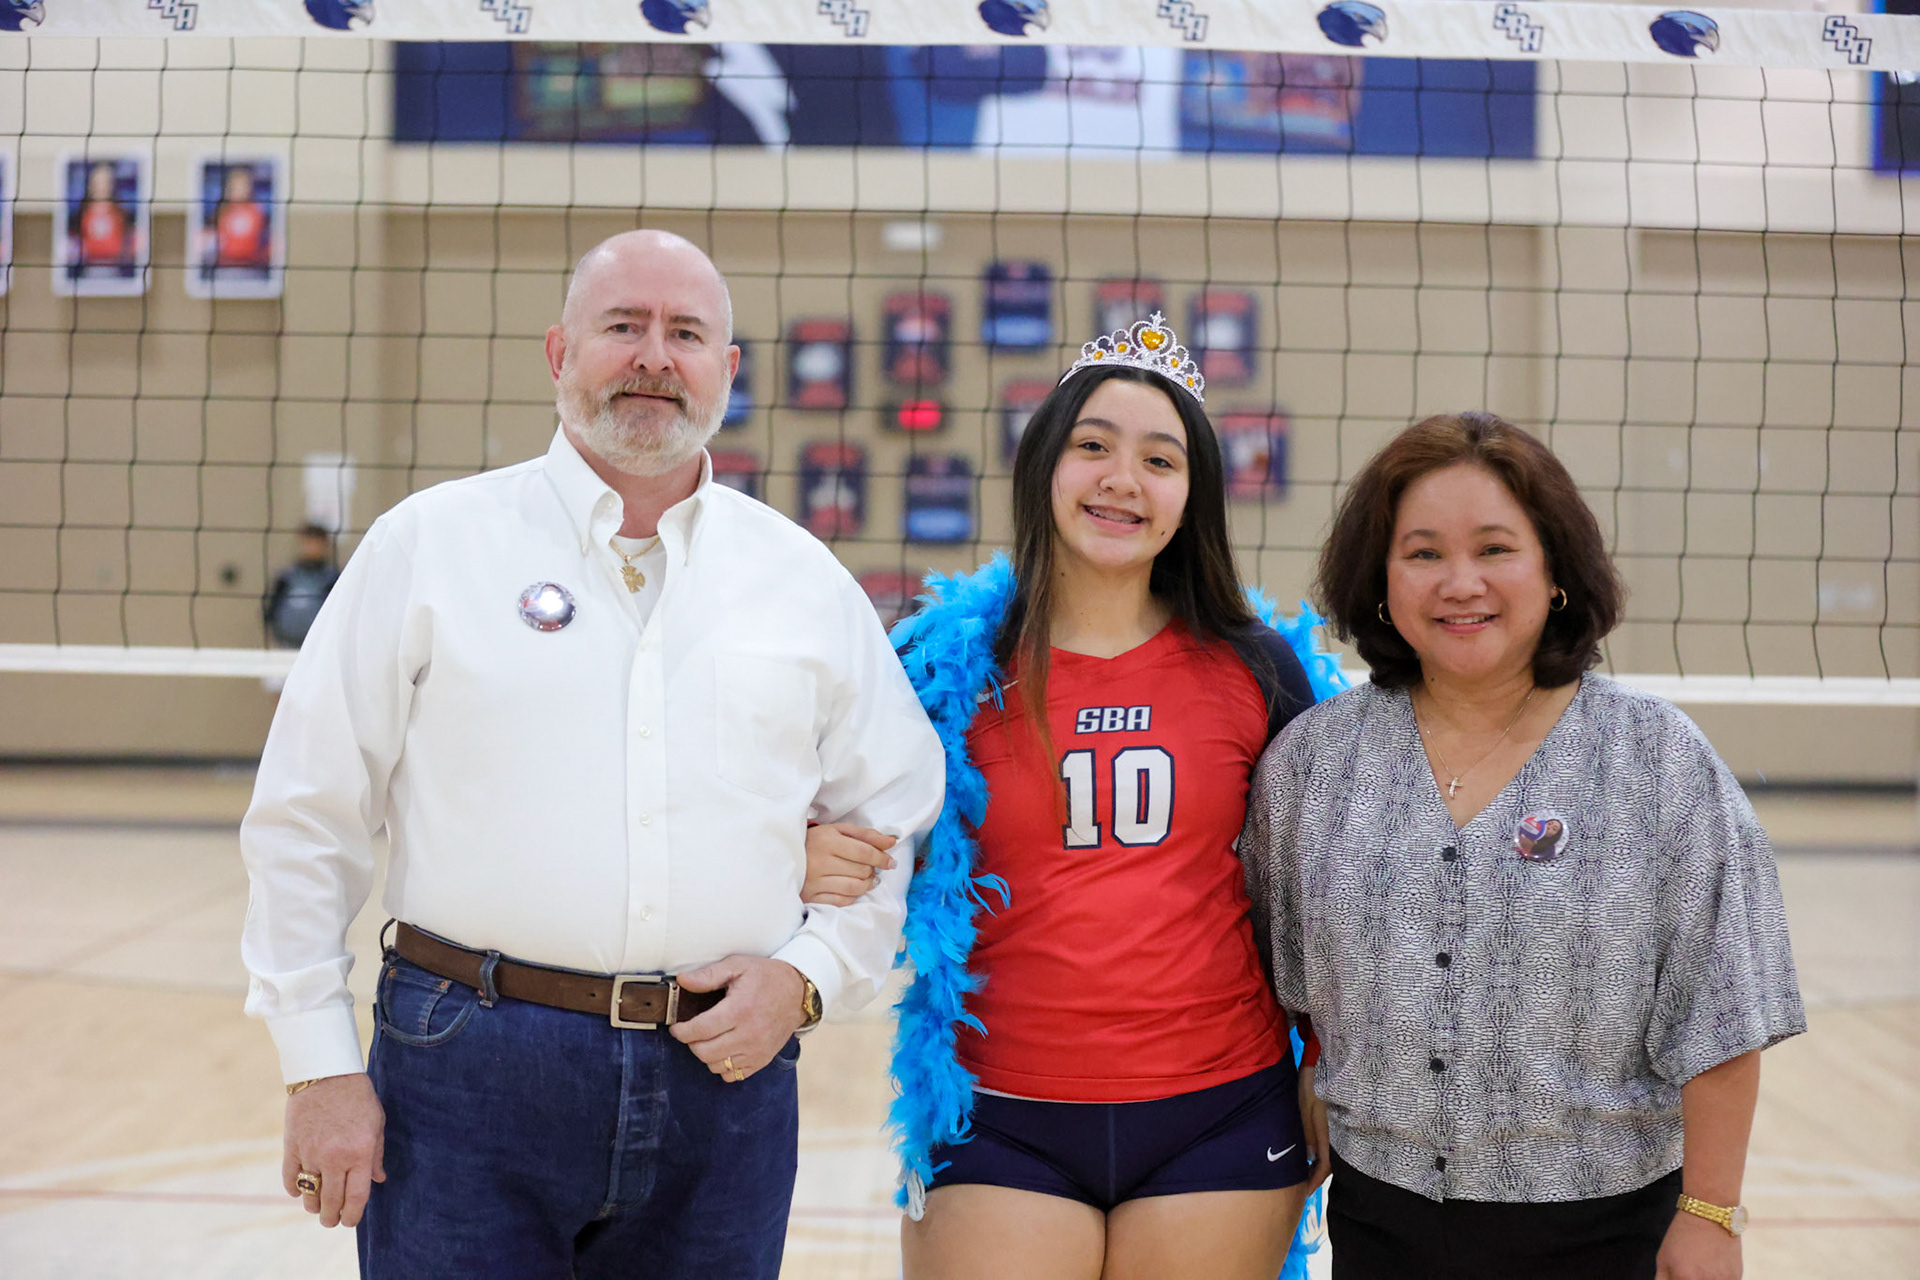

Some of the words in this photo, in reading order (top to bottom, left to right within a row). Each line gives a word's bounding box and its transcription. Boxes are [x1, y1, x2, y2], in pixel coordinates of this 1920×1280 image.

[1157, 0, 1208, 42] SBA
[1493, 3, 1543, 53] SBA
[1822, 15, 1872, 65] SBA
[1075, 705, 1152, 735] SBA
[1058, 745, 1175, 850] 10
